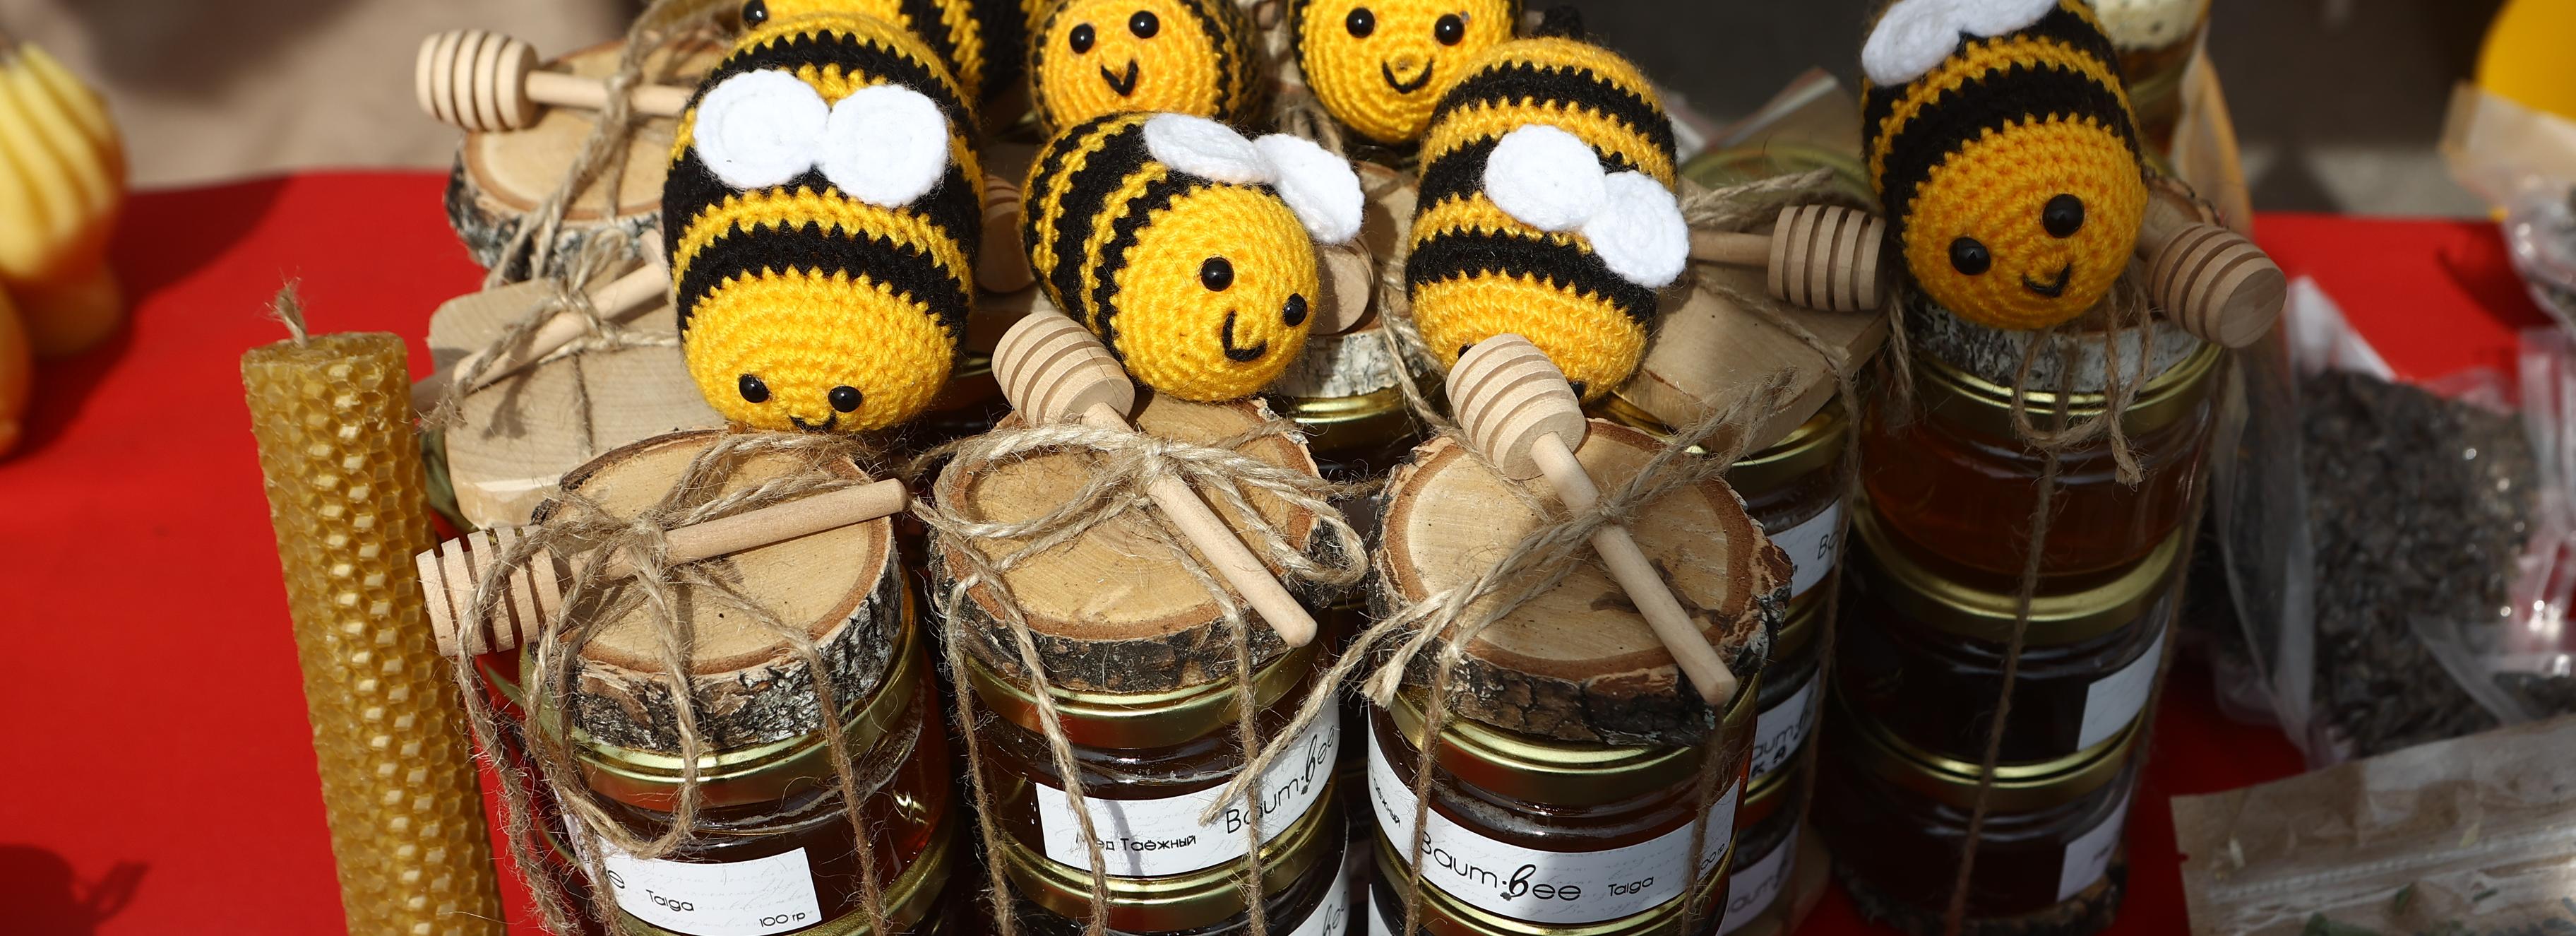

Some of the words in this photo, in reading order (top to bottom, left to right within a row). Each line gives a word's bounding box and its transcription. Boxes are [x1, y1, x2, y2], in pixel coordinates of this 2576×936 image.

[1120, 834, 1197, 852] Таёжный
[1608, 876, 1654, 897] Taiga
[645, 889, 695, 912] Taiga
[759, 914, 789, 928] 100
